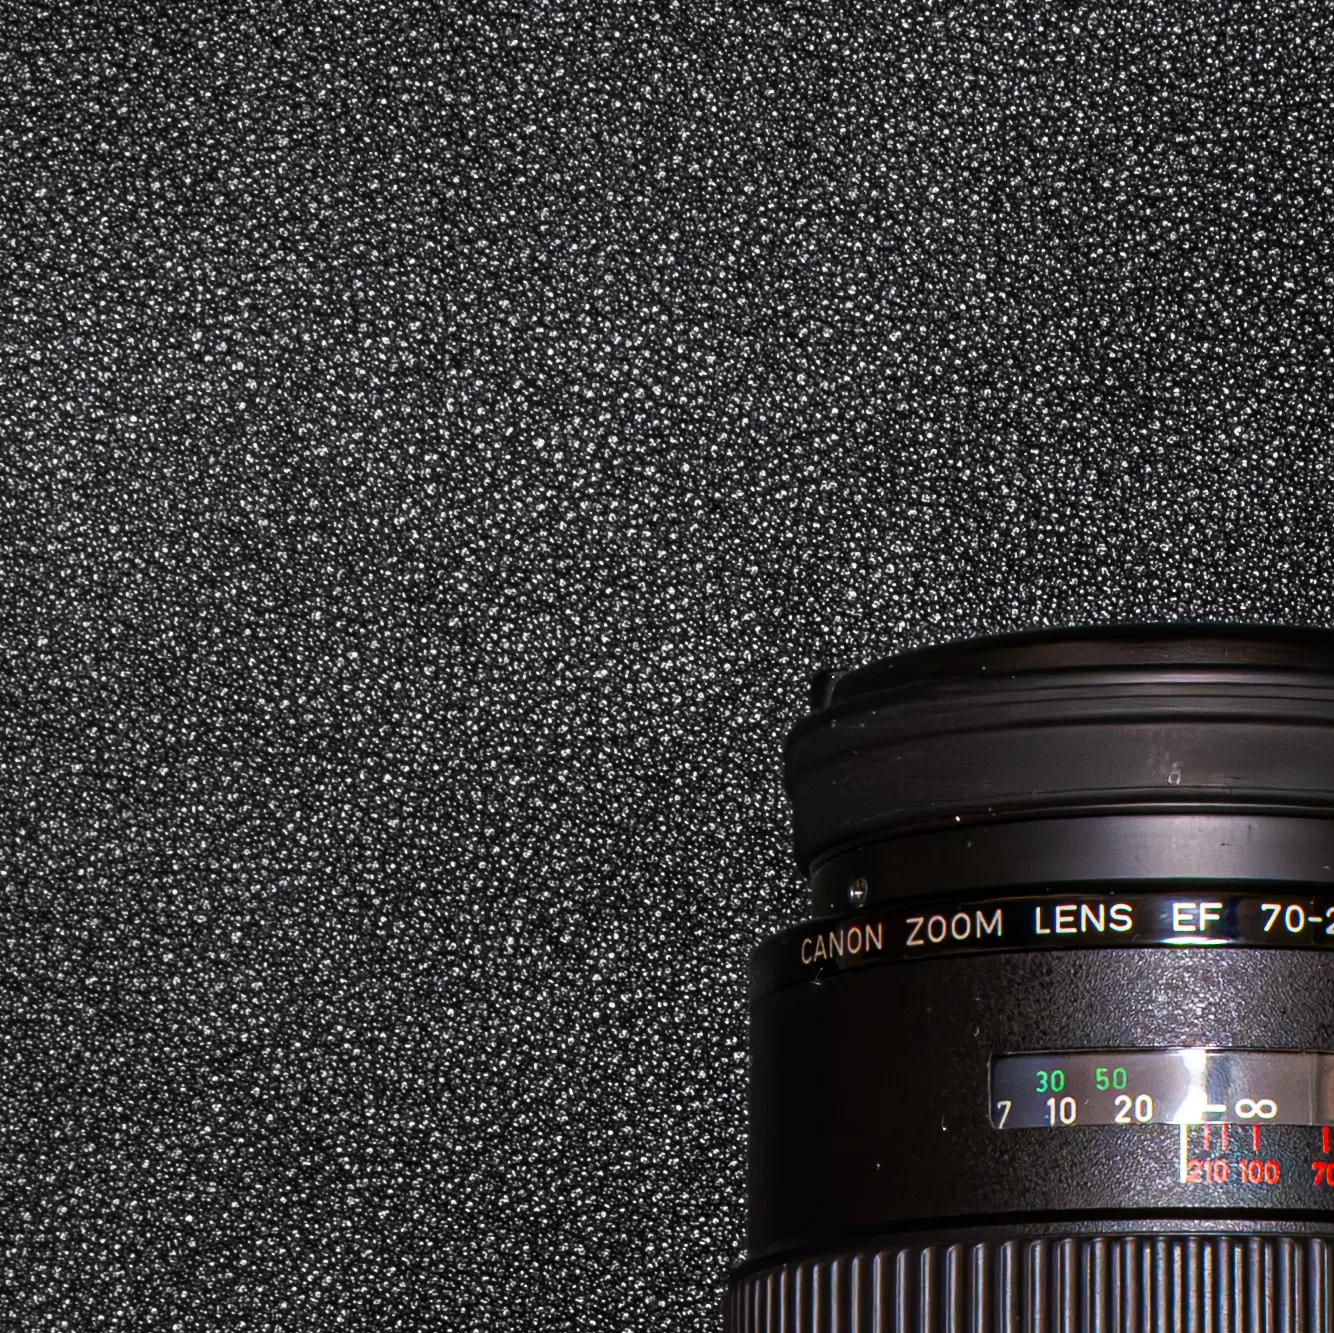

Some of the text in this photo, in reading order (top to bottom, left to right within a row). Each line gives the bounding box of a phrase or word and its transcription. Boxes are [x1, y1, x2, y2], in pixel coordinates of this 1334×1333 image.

[801, 922, 884, 965] CANON
[905, 909, 1003, 946] ZOOM
[1034, 903, 1134, 935] LENS
[1172, 902, 1222, 932] EF
[1035, 1069, 1066, 1093] 30
[1095, 1067, 1128, 1091] 50
[996, 1100, 1012, 1129] 7
[1046, 1096, 1077, 1126] 10
[1113, 1094, 1154, 1124] 20
[1186, 1160, 1229, 1184] 210
[1238, 1160, 1280, 1185] 100
